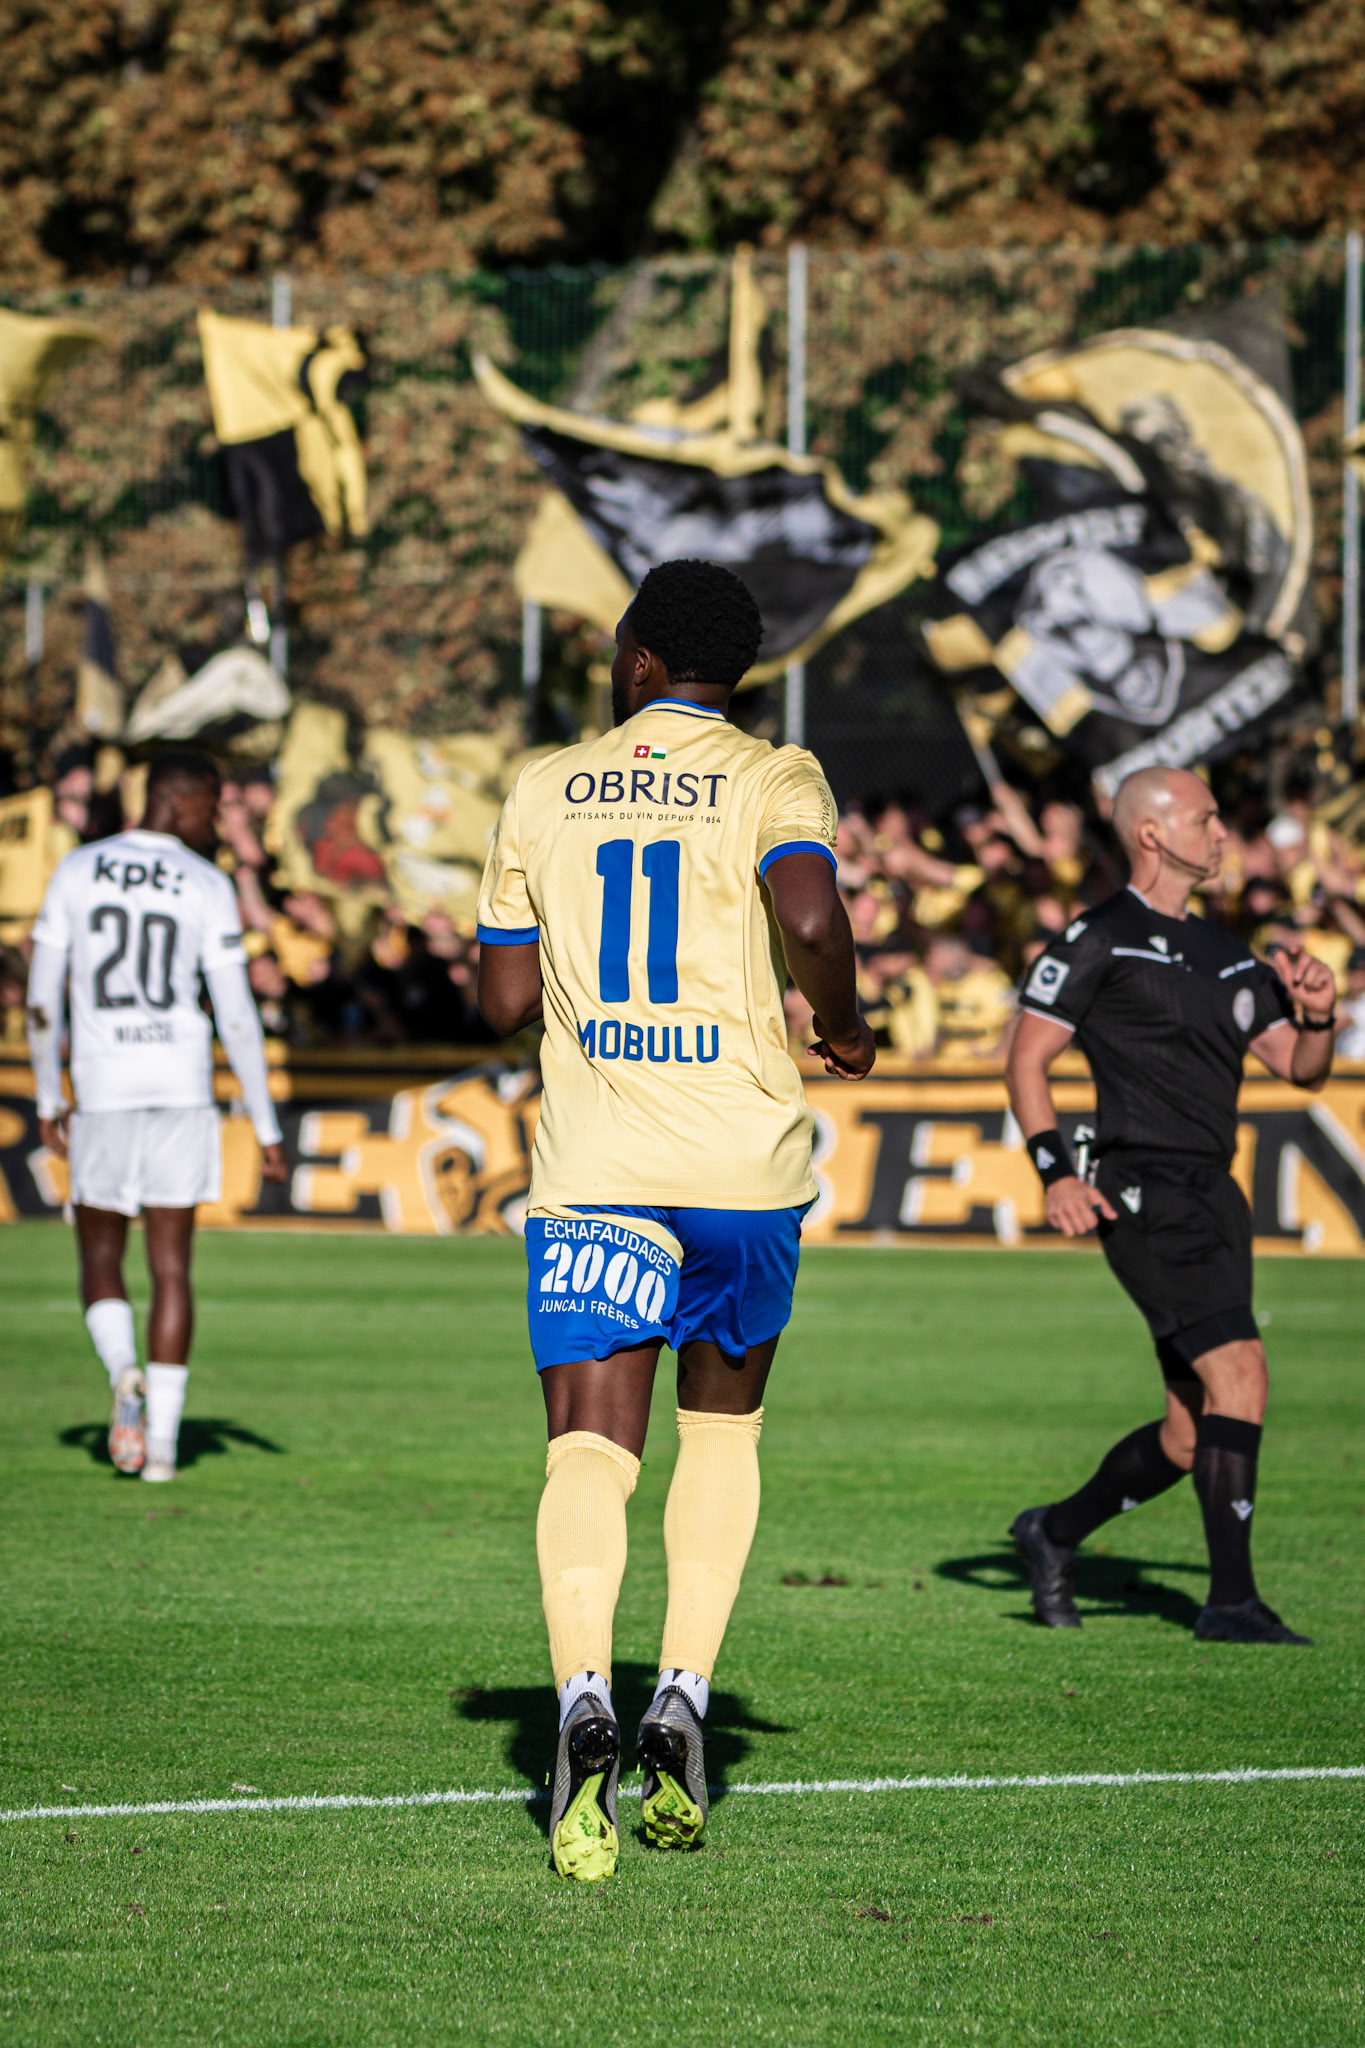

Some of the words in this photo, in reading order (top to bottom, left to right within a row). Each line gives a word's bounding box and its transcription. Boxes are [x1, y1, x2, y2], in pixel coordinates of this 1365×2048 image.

[565, 769, 728, 808] OBRIST
[564, 812, 614, 821] ARTISANS
[620, 812, 633, 820] DU
[637, 811, 653, 820] VIN
[658, 813, 694, 822] DEPUIS
[700, 815, 721, 824] 1854
[93, 853, 184, 895] kpt:
[596, 839, 680, 1004] 11
[90, 904, 178, 1012] 20
[577, 1019, 719, 1063] MOBULU
[544, 1220, 674, 1276] ECHAFAUDAGES
[540, 1242, 666, 1323] 2000
[538, 1299, 585, 1313] JUNCAJ
[590, 1301, 640, 1330] FRÈRES
